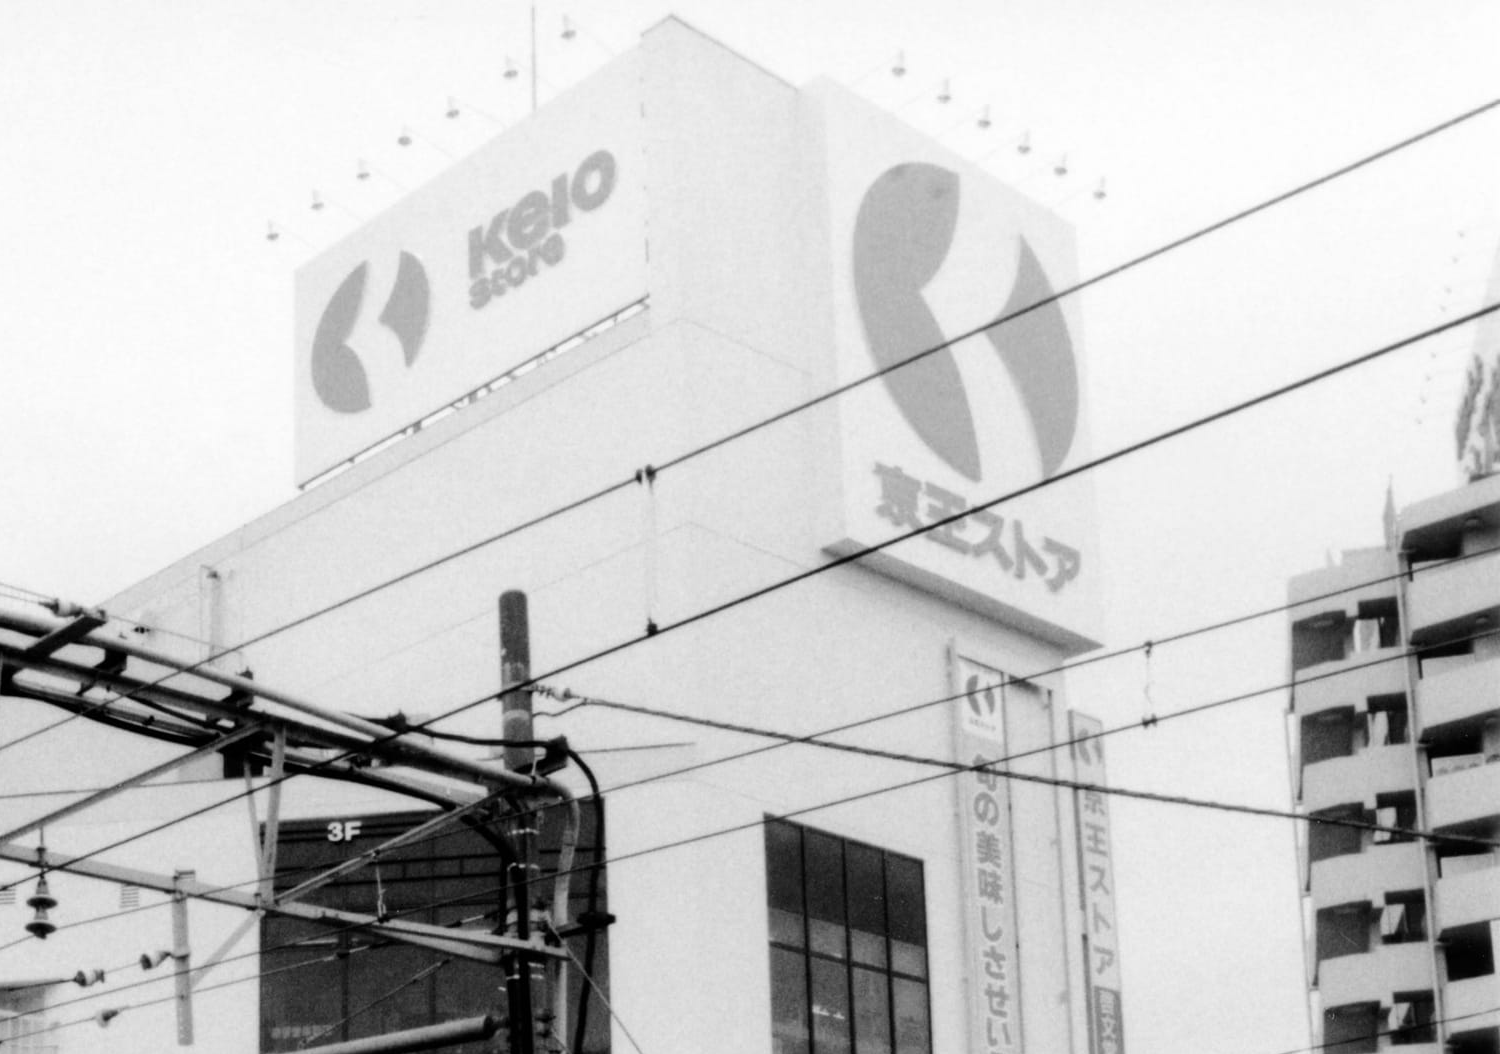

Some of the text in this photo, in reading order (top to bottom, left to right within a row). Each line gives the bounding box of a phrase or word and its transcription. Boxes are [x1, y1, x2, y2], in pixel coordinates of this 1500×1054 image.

[873, 461, 1081, 593] 京王ストア
[327, 821, 362, 843] 3F
